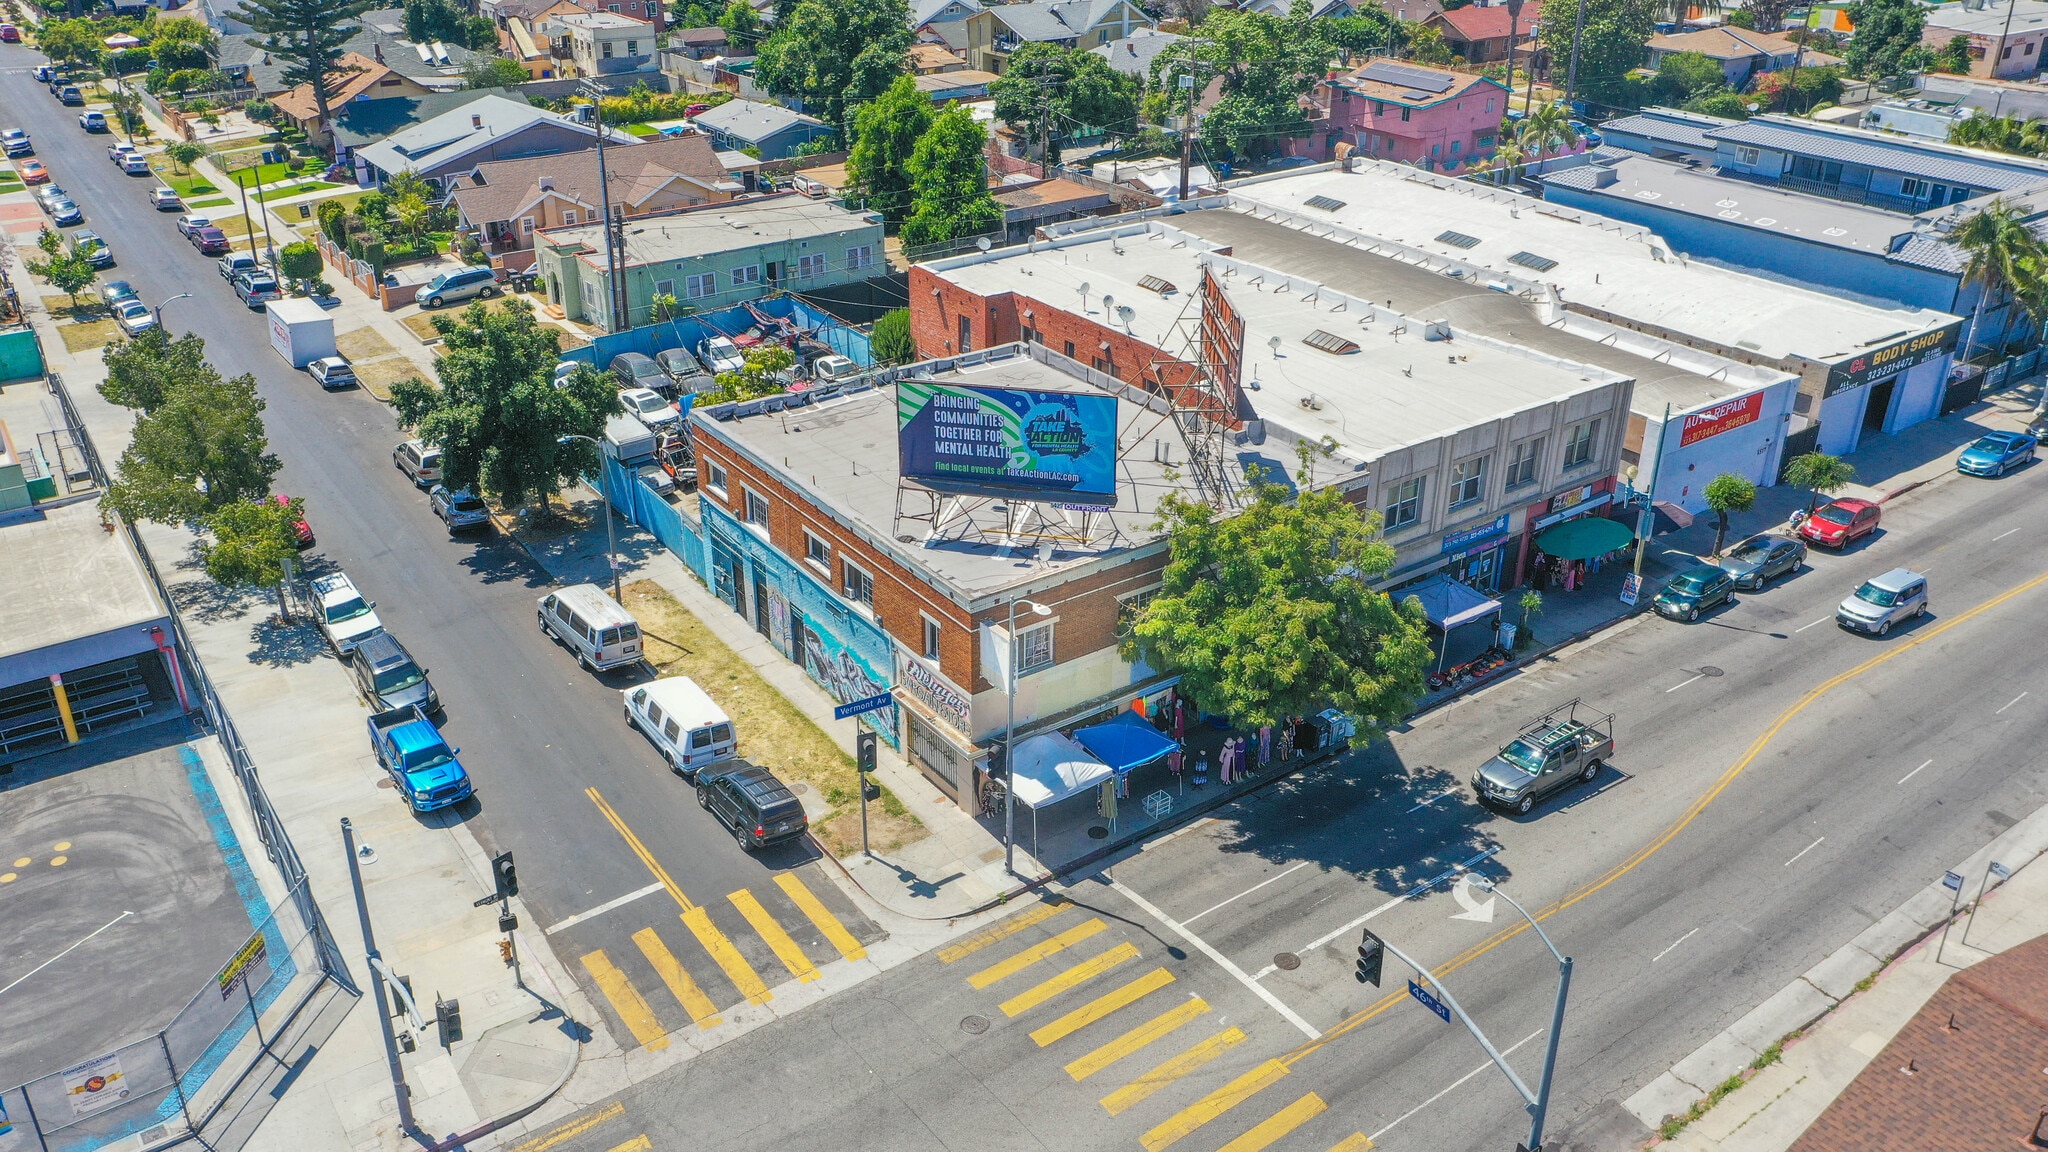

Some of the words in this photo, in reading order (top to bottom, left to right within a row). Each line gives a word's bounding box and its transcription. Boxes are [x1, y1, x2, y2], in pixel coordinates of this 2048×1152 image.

[1872, 343, 1909, 366] BODY
[1909, 330, 1945, 352] SHOP
[933, 394, 980, 410] BRINGING
[1714, 398, 1748, 418] REPAIR
[934, 410, 1004, 427] COMMUNITIES
[1032, 421, 1065, 432] TAKE
[934, 425, 982, 441] TOGETHER
[984, 429, 1003, 443] FOR
[1030, 431, 1080, 444] ACTION
[935, 441, 974, 456] MENTAL
[976, 444, 1012, 459] HEALTH
[935, 461, 950, 471] Find
[951, 463, 969, 472] local
[970, 465, 995, 475] events
[996, 468, 1005, 476] at
[1007, 467, 1079, 482] TakeActionLAC.com
[1065, 503, 1108, 513] OUTFRONT
[840, 700, 873, 715] Vermont
[877, 697, 887, 706] Av
[939, 702, 972, 739] STORE
[1412, 987, 1433, 1005] 46th
[1436, 1004, 1446, 1017] St
[62, 1053, 116, 1076] CONGRATULATIONS
